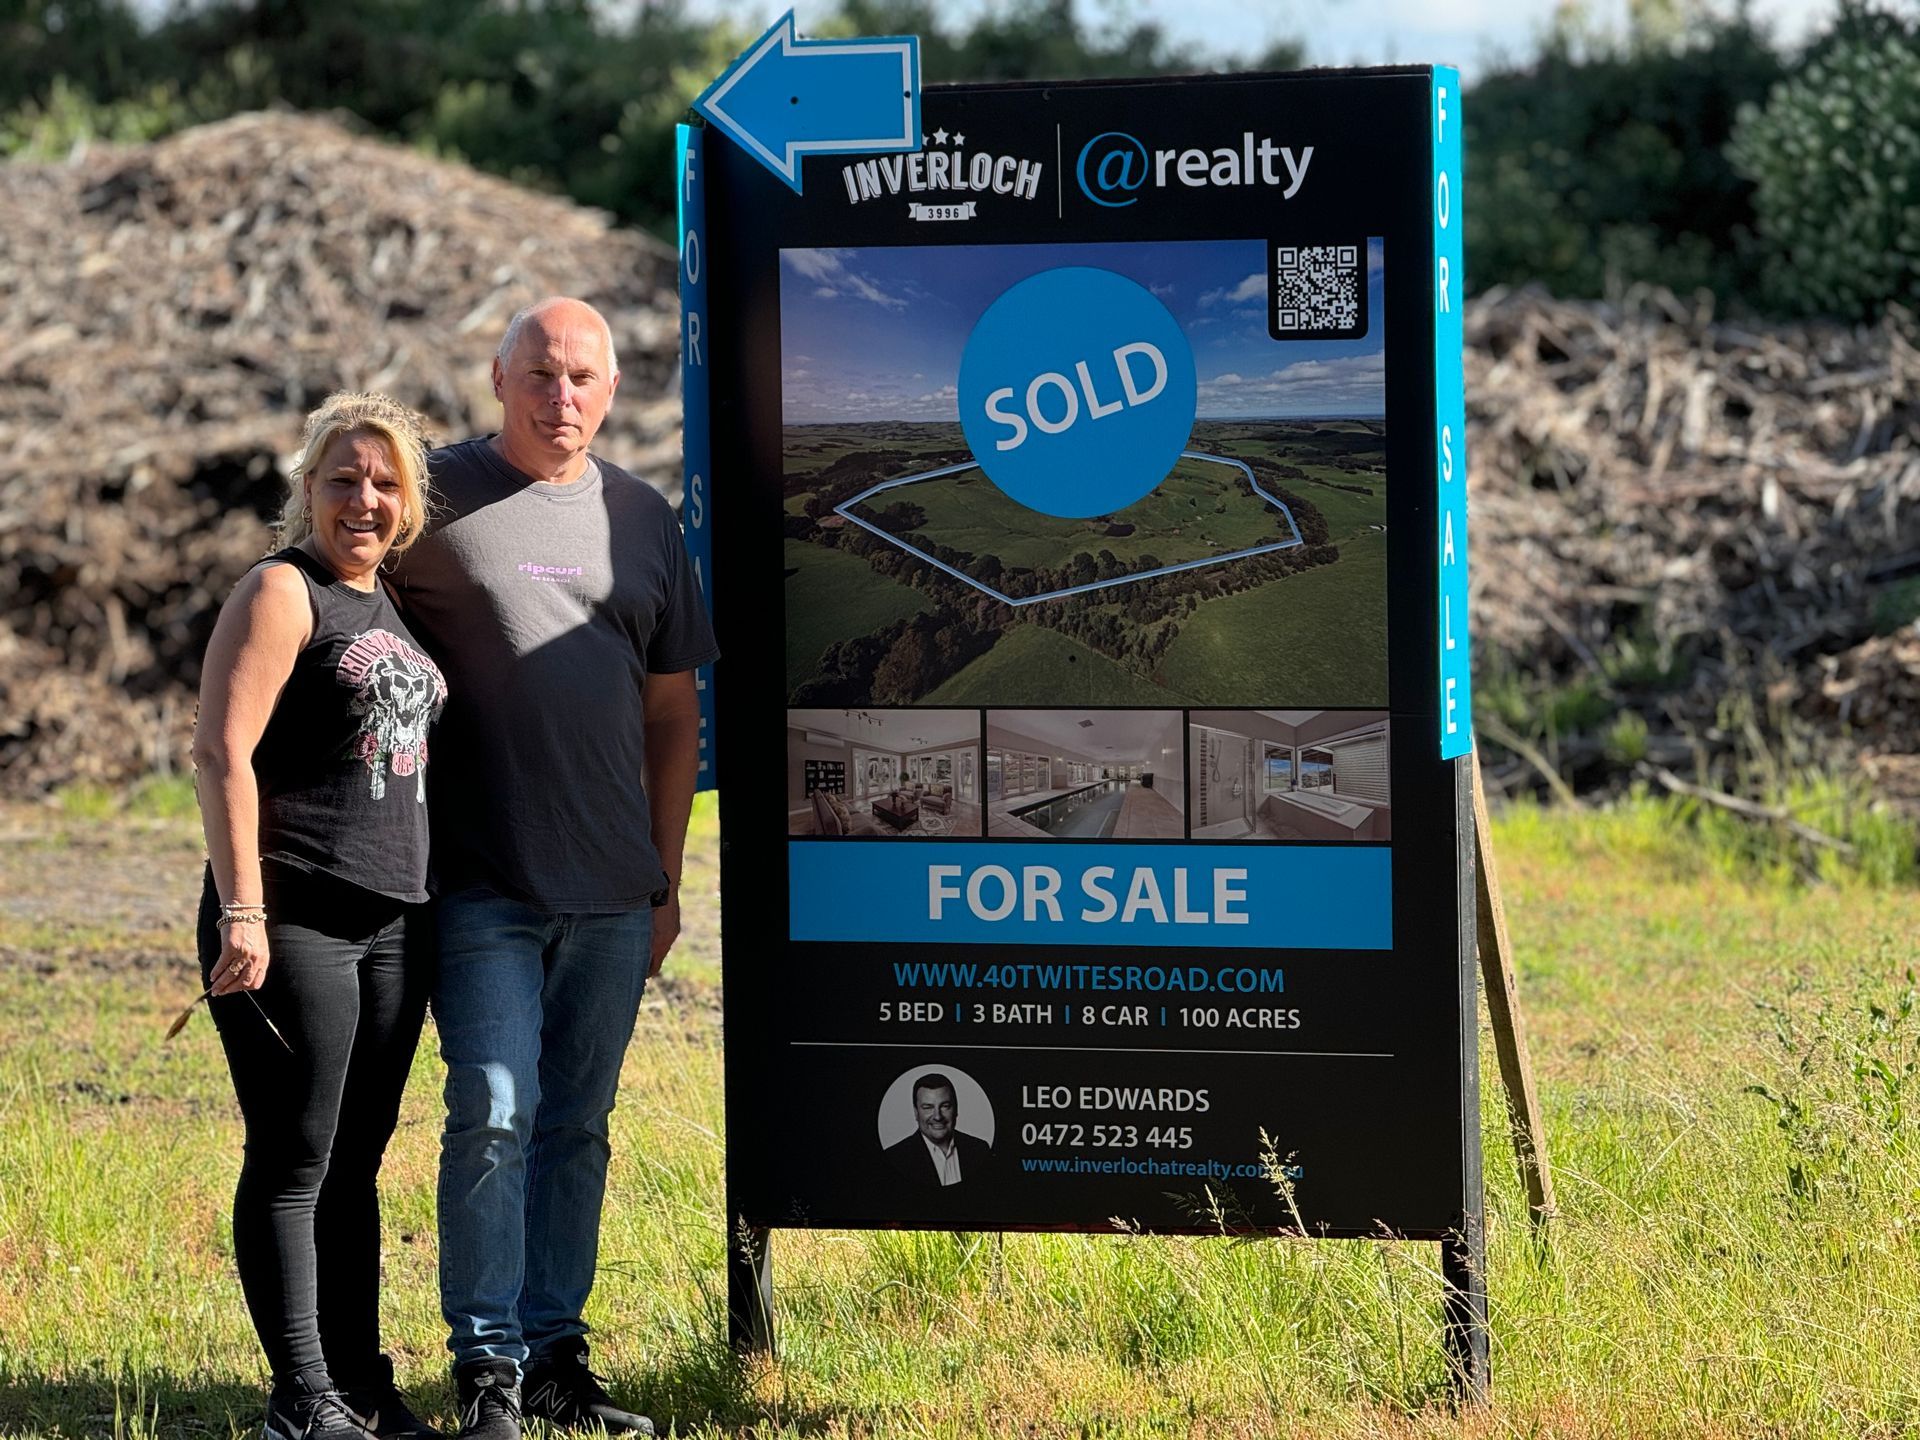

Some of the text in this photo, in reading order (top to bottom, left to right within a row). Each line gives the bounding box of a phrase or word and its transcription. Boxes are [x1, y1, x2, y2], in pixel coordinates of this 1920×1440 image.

[842, 151, 1042, 204] INVERLOCH
[928, 207, 960, 219] 3996
[685, 149, 701, 366] FOR
[985, 341, 1168, 451] SOLD
[1437, 86, 1457, 734] FOR SALE
[929, 865, 1249, 924] FOR SALE
[893, 963, 1285, 993] WWW.40TWITESROAD.COM
[878, 1002, 1301, 1029] 5 BED 3 BATH 8 CAR 100 ACRES
[1022, 1086, 1210, 1112] LEO EDWARDS
[1021, 1123, 1193, 1149] 0472 523 445
[1022, 1156, 1304, 1181] www.inverlochatrealty.cou
